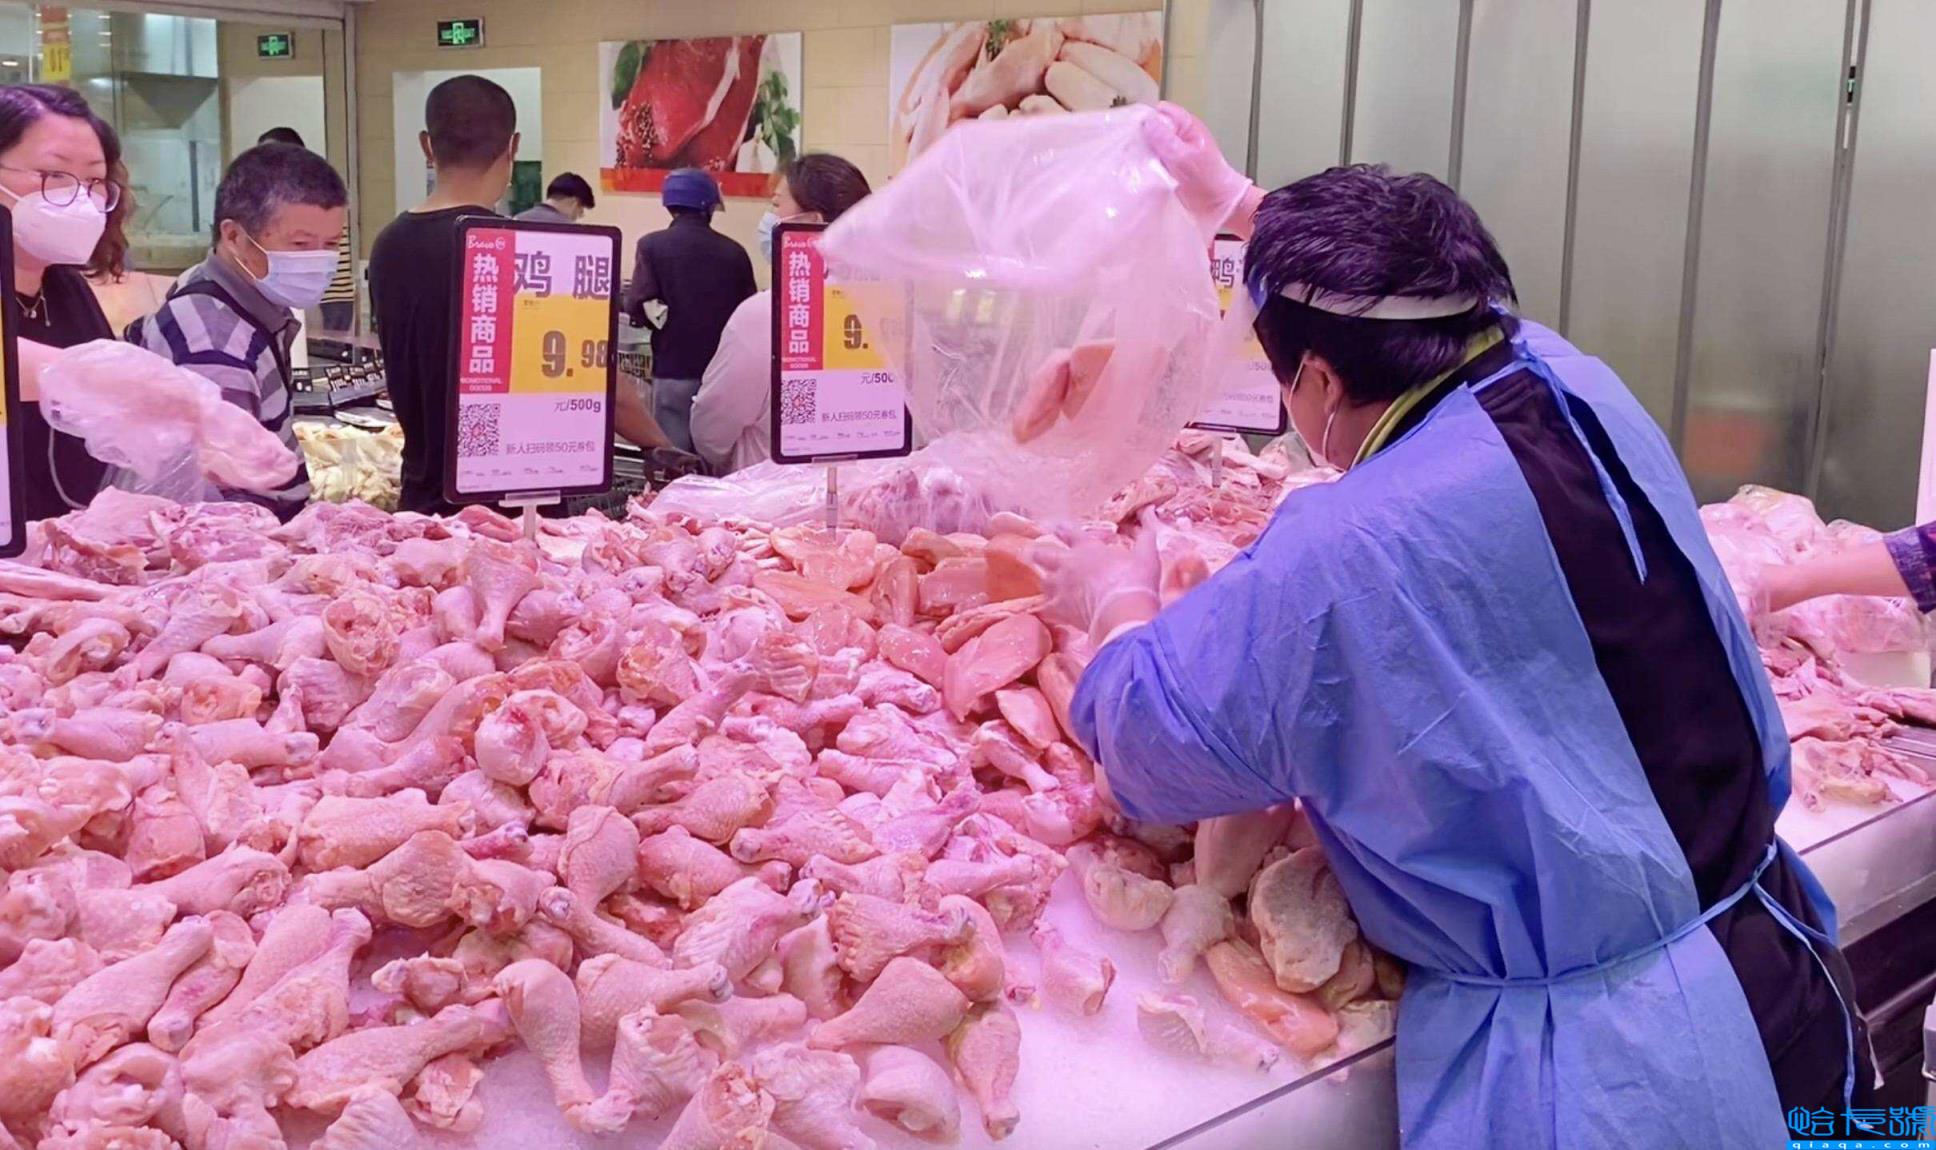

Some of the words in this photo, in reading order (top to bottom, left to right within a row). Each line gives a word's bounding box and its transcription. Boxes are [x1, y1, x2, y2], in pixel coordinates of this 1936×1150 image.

[513, 250, 610, 300] 鸡腿
[470, 253, 499, 374] 热销商品
[788, 251, 811, 354] 热销商品
[541, 330, 608, 378] 9.98
[553, 398, 602, 413] 元/500g
